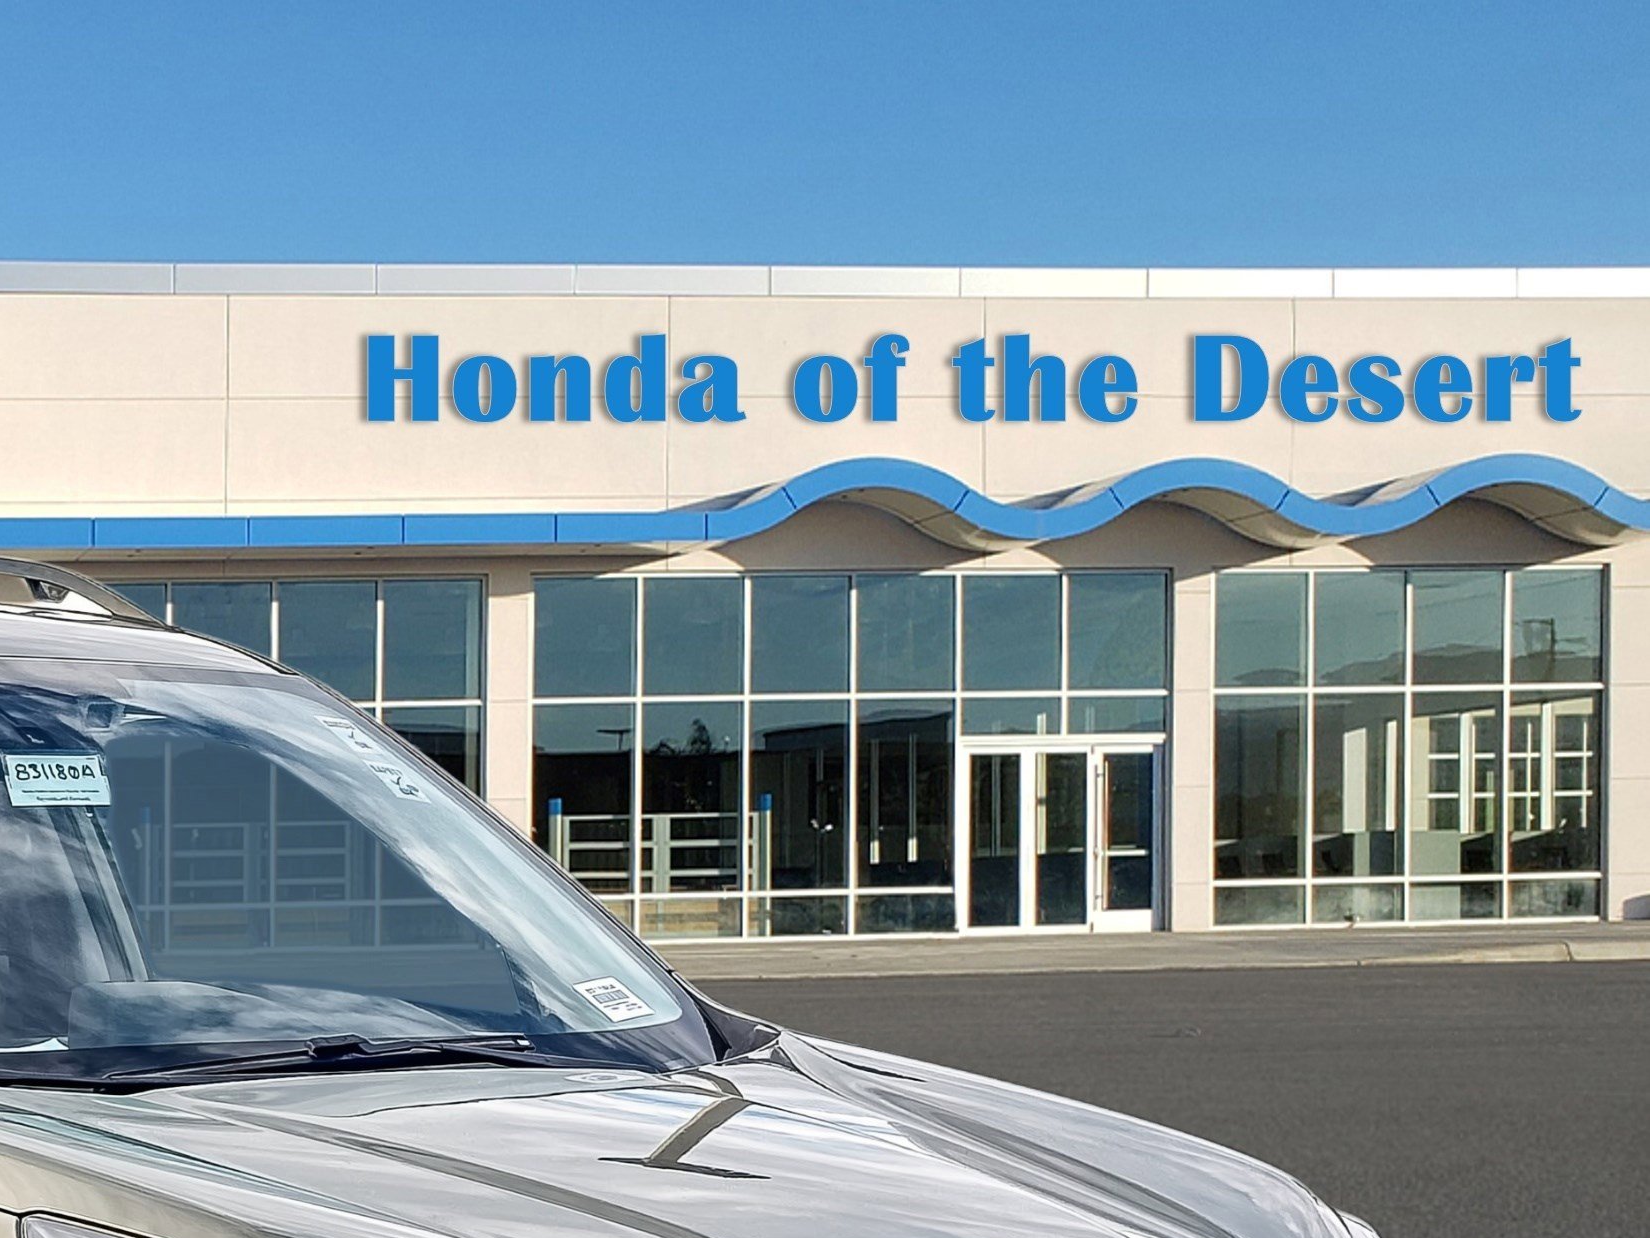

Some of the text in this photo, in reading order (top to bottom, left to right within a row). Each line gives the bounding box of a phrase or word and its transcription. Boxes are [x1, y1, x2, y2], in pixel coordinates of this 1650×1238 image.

[366, 333, 1582, 424] Honda of the Desert
